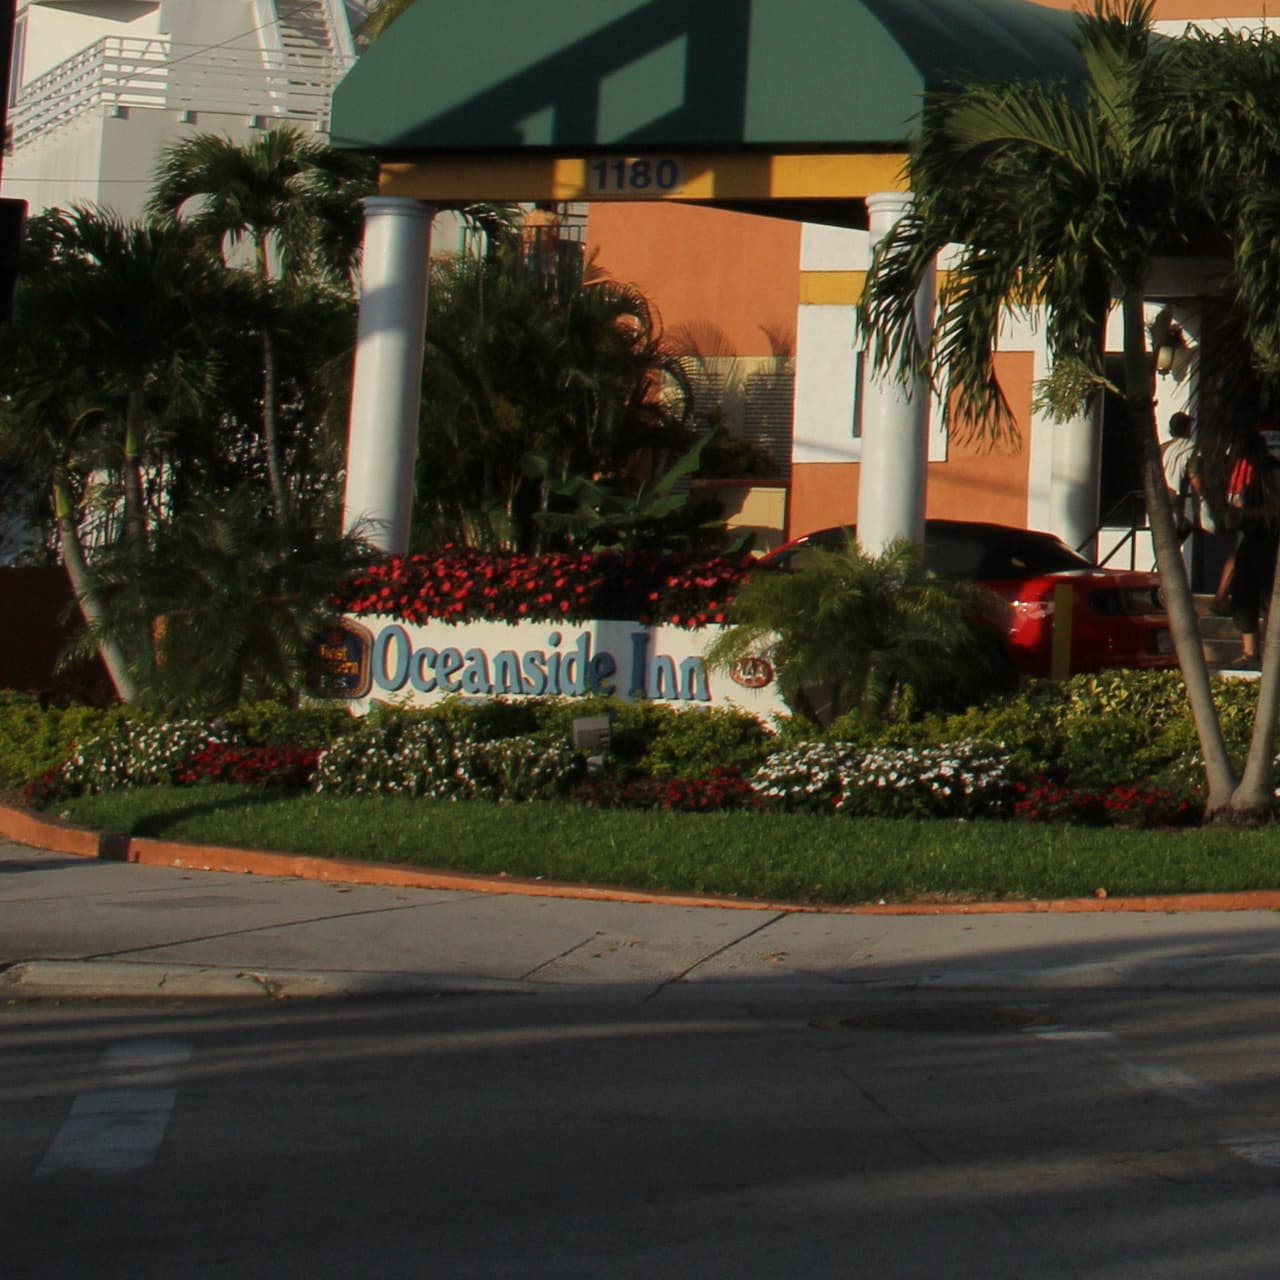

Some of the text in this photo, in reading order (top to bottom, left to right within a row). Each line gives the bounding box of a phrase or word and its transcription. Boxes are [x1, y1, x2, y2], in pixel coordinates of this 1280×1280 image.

[592, 158, 679, 190] 1180
[372, 624, 711, 702] Oceanside Inn
